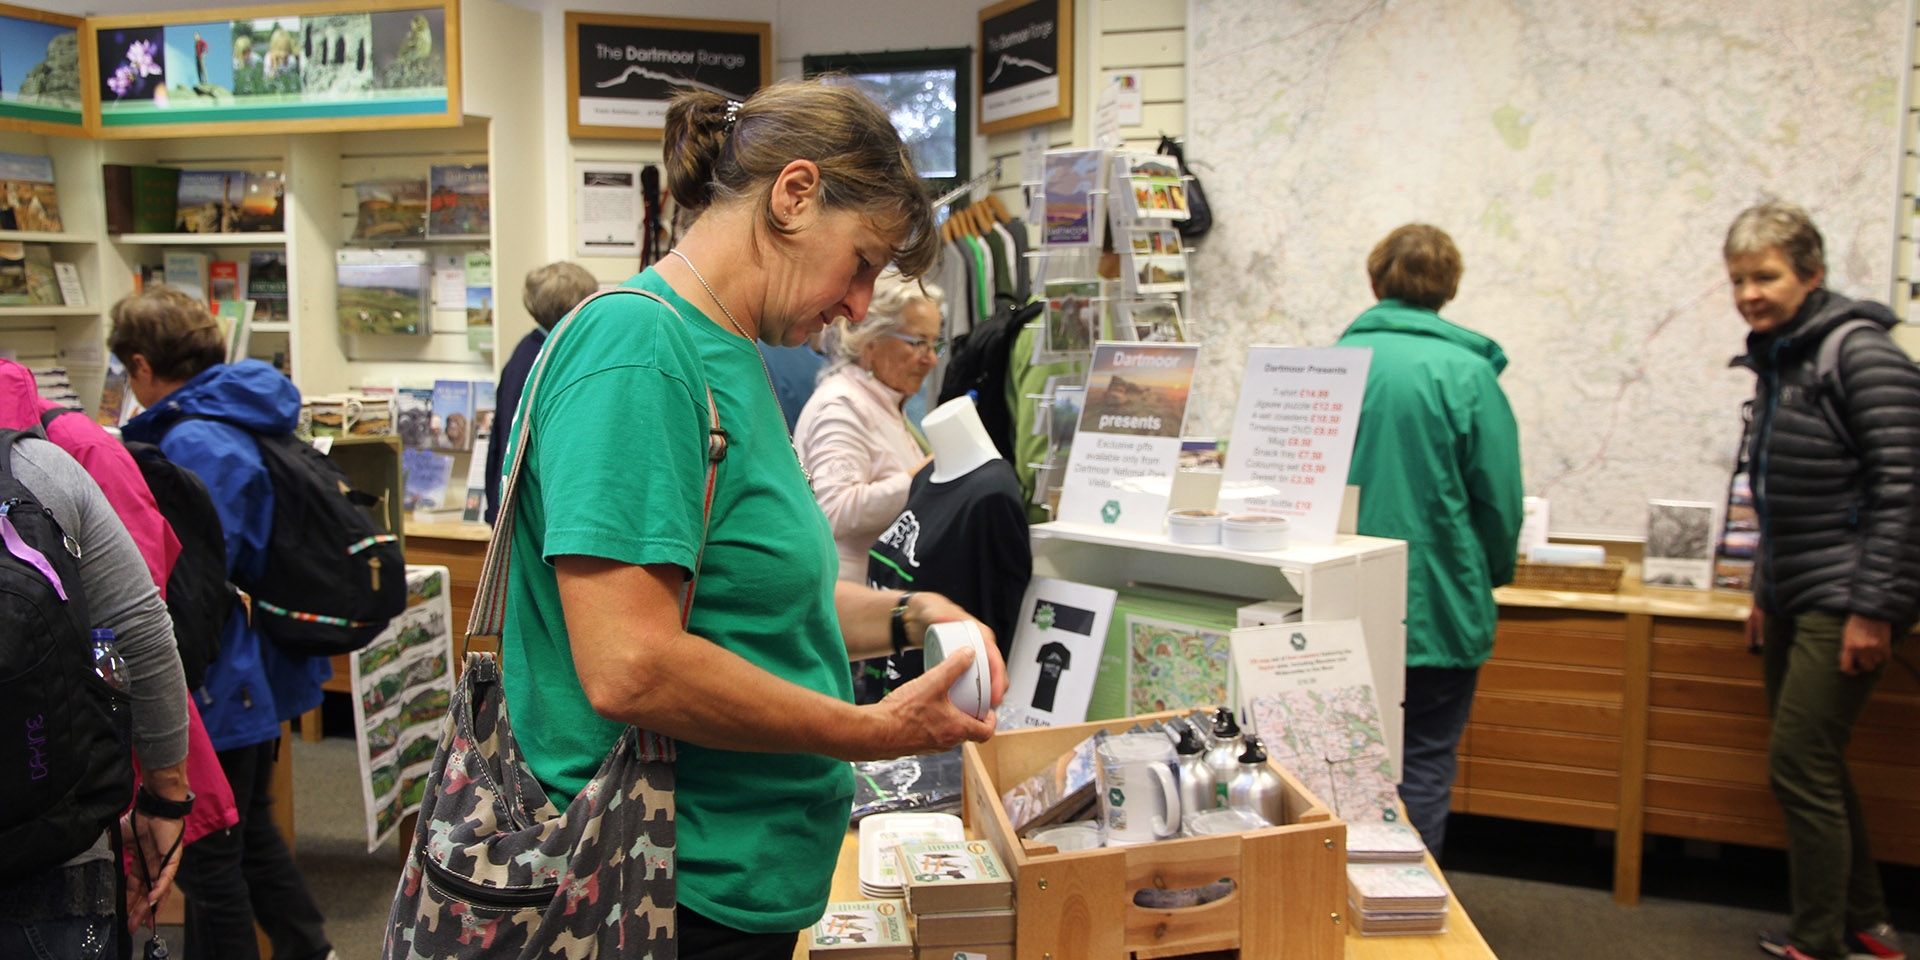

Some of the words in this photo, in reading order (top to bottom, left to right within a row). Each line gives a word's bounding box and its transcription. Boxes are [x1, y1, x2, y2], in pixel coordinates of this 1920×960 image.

[596, 43, 623, 60] The
[626, 45, 694, 63] Dartmoor
[697, 49, 746, 69] Range
[1112, 351, 1180, 367] Dartmoor
[1264, 363, 1305, 373] Dartmoor
[1307, 365, 1347, 374] Presents
[1255, 401, 1281, 410] Jigsaw
[1283, 402, 1310, 410] puzzle
[1099, 414, 1162, 430] presents
[1291, 425, 1312, 435] DVD
[1096, 440, 1134, 449] Exclusive
[1136, 442, 1153, 451] gifts
[1268, 437, 1285, 447] Mug
[1086, 453, 1120, 462] available
[1122, 456, 1138, 464] only
[1142, 455, 1160, 464] from
[1254, 448, 1278, 456] Snack
[1281, 450, 1296, 459] tray
[1074, 463, 1110, 474] Dartmoor
[1113, 467, 1145, 477] National
[1245, 459, 1284, 471] Colouring
[1251, 471, 1276, 480] Sweet
[1270, 499, 1293, 507] bottle
[25, 713, 48, 780] DAKINE
